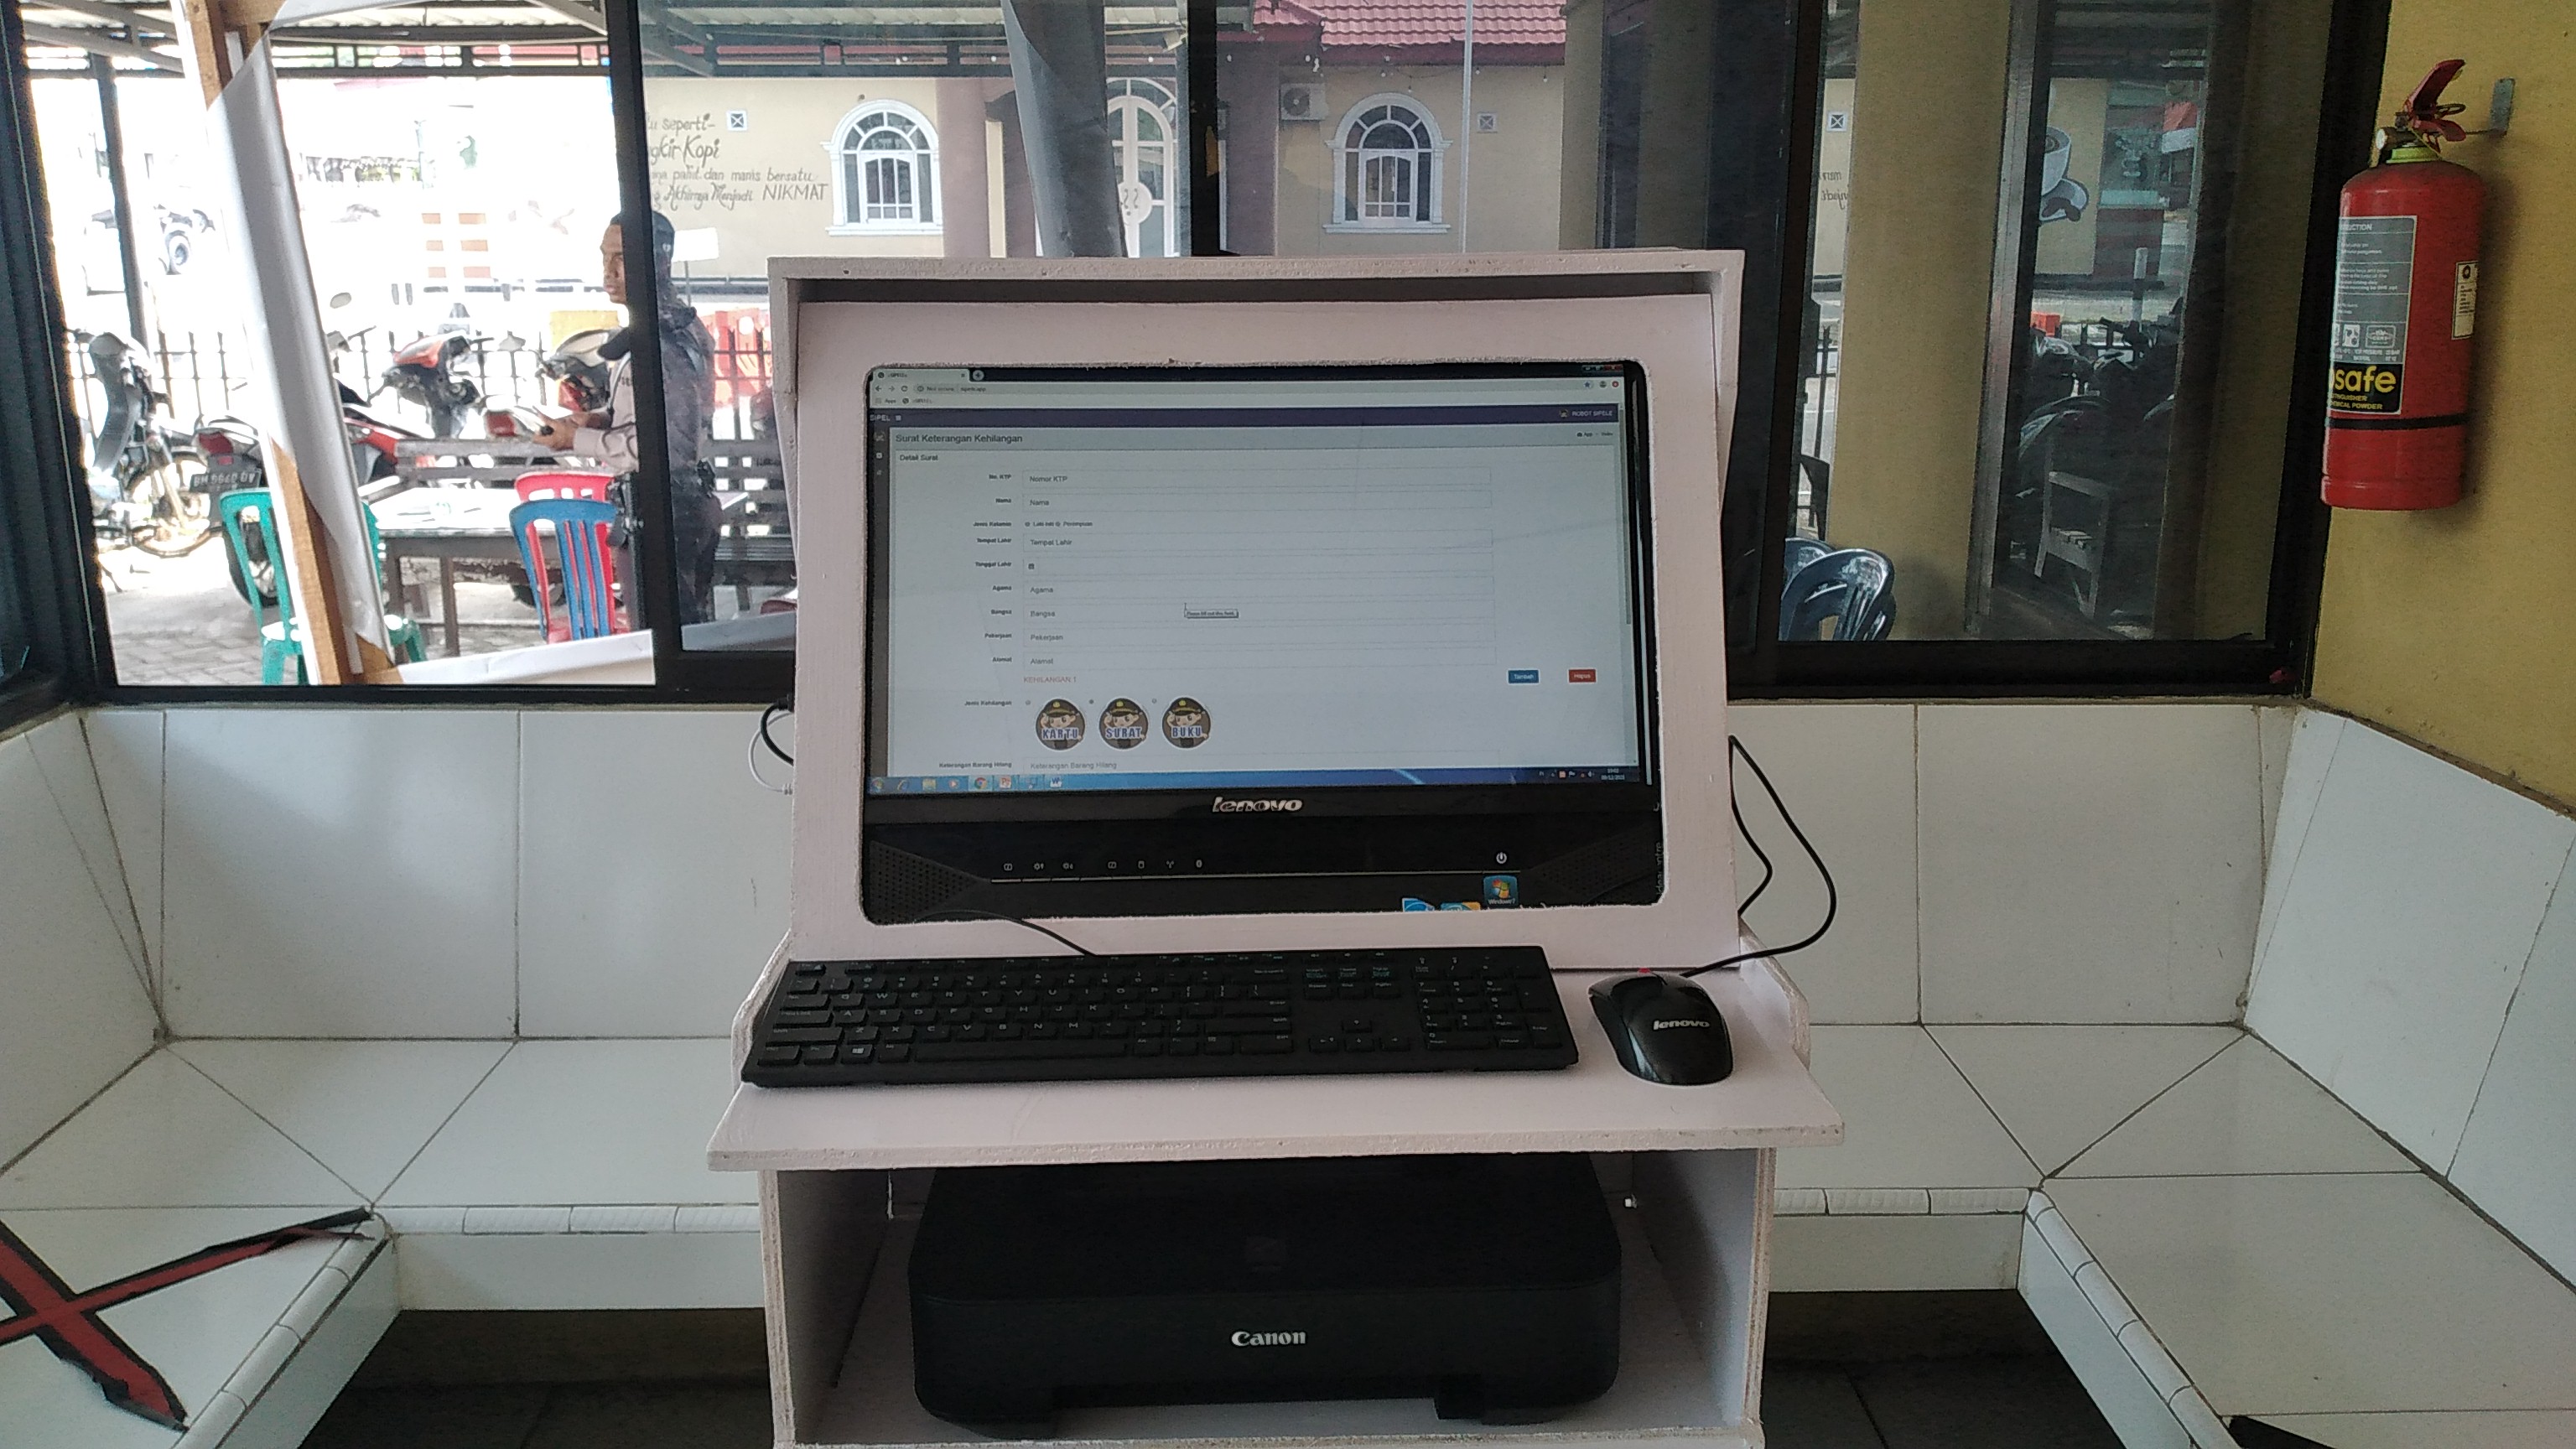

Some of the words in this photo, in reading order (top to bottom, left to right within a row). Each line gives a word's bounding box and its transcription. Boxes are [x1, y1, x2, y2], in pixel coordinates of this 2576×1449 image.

[683, 134, 720, 169] Kopi
[704, 167, 724, 180] dan
[767, 167, 815, 182] bersatu
[762, 184, 828, 201] NIKMAT
[2330, 365, 2397, 394] safe
[895, 434, 919, 443] Surat
[922, 434, 972, 444] Keterangan
[974, 434, 1023, 444] Kehilangan
[1042, 728, 1078, 740] KARTU
[1105, 727, 1141, 739] SURAT
[1171, 726, 1202, 737] BUKU
[1030, 762, 1069, 771] Keterangan
[1070, 761, 1094, 770] Barang
[1095, 761, 1117, 769] Hilang
[1212, 797, 1302, 813] lenovo
[1653, 1020, 1710, 1030] lenovo
[1231, 1331, 1306, 1347] Canon
